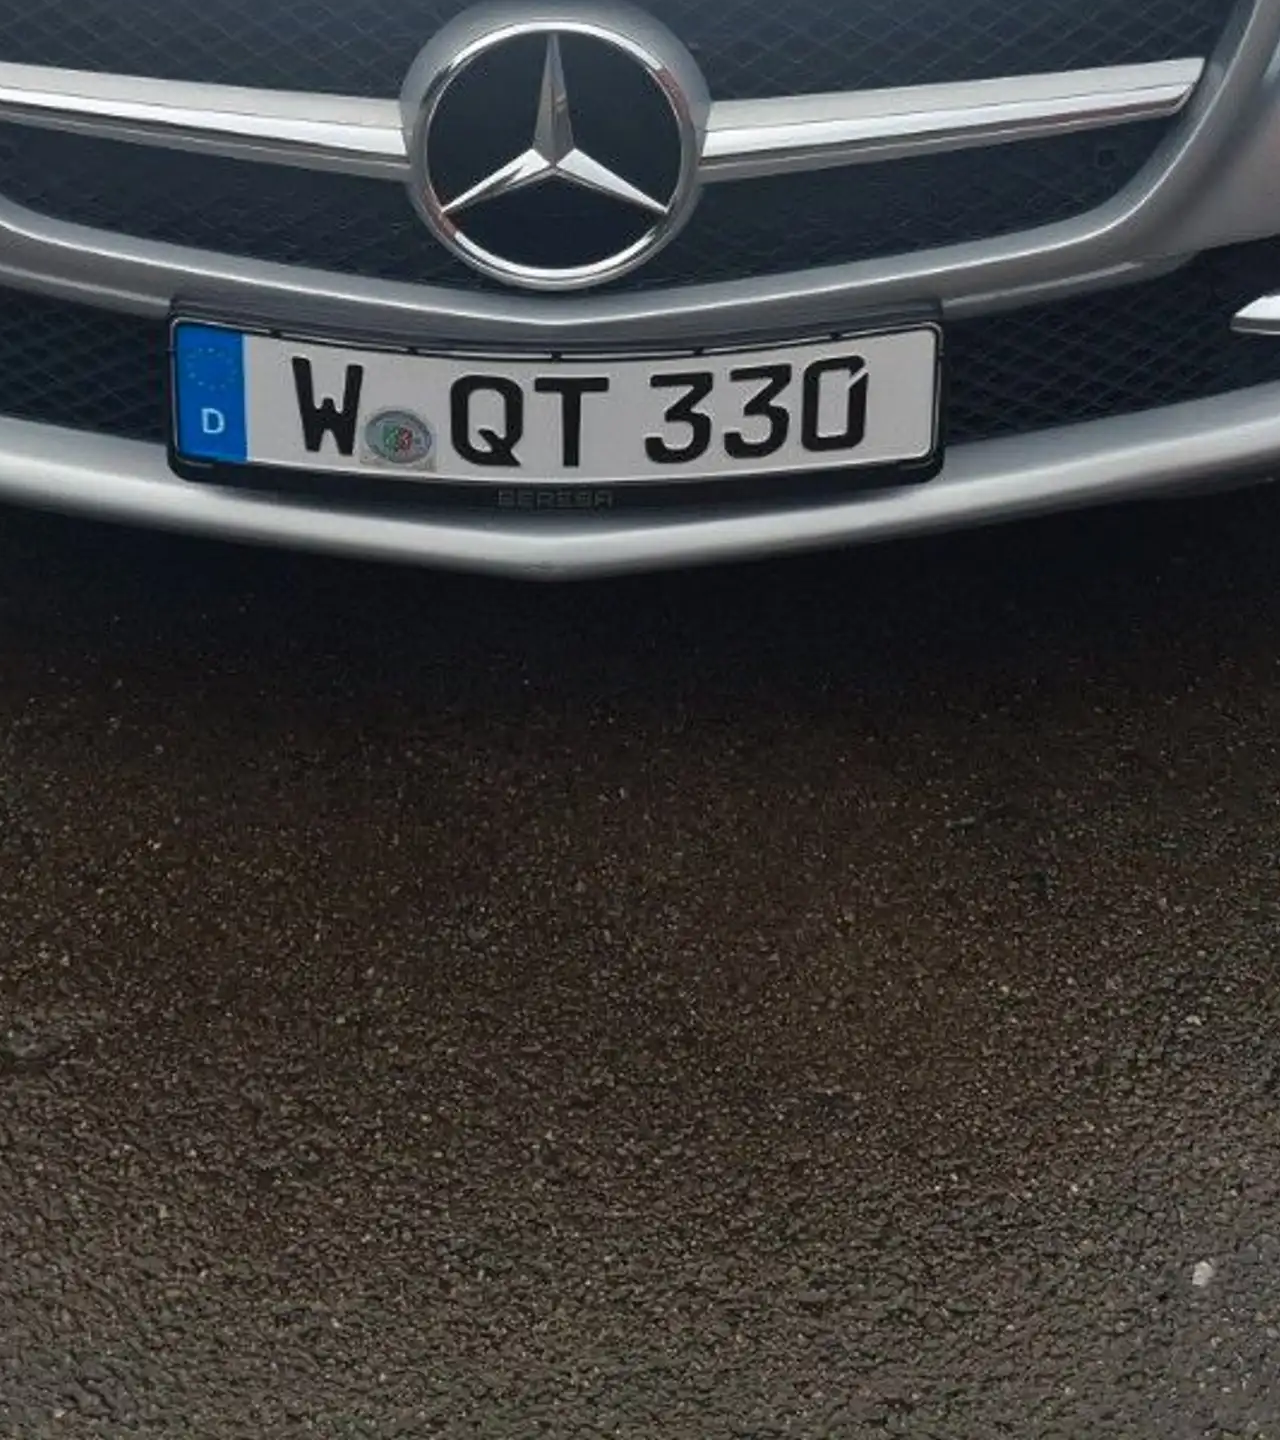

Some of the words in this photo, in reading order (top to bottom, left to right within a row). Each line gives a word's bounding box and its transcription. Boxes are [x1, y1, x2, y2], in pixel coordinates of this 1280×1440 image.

[200, 406, 226, 435] D
[291, 356, 364, 456] W
[449, 374, 610, 468] QT
[644, 354, 869, 464] 330
